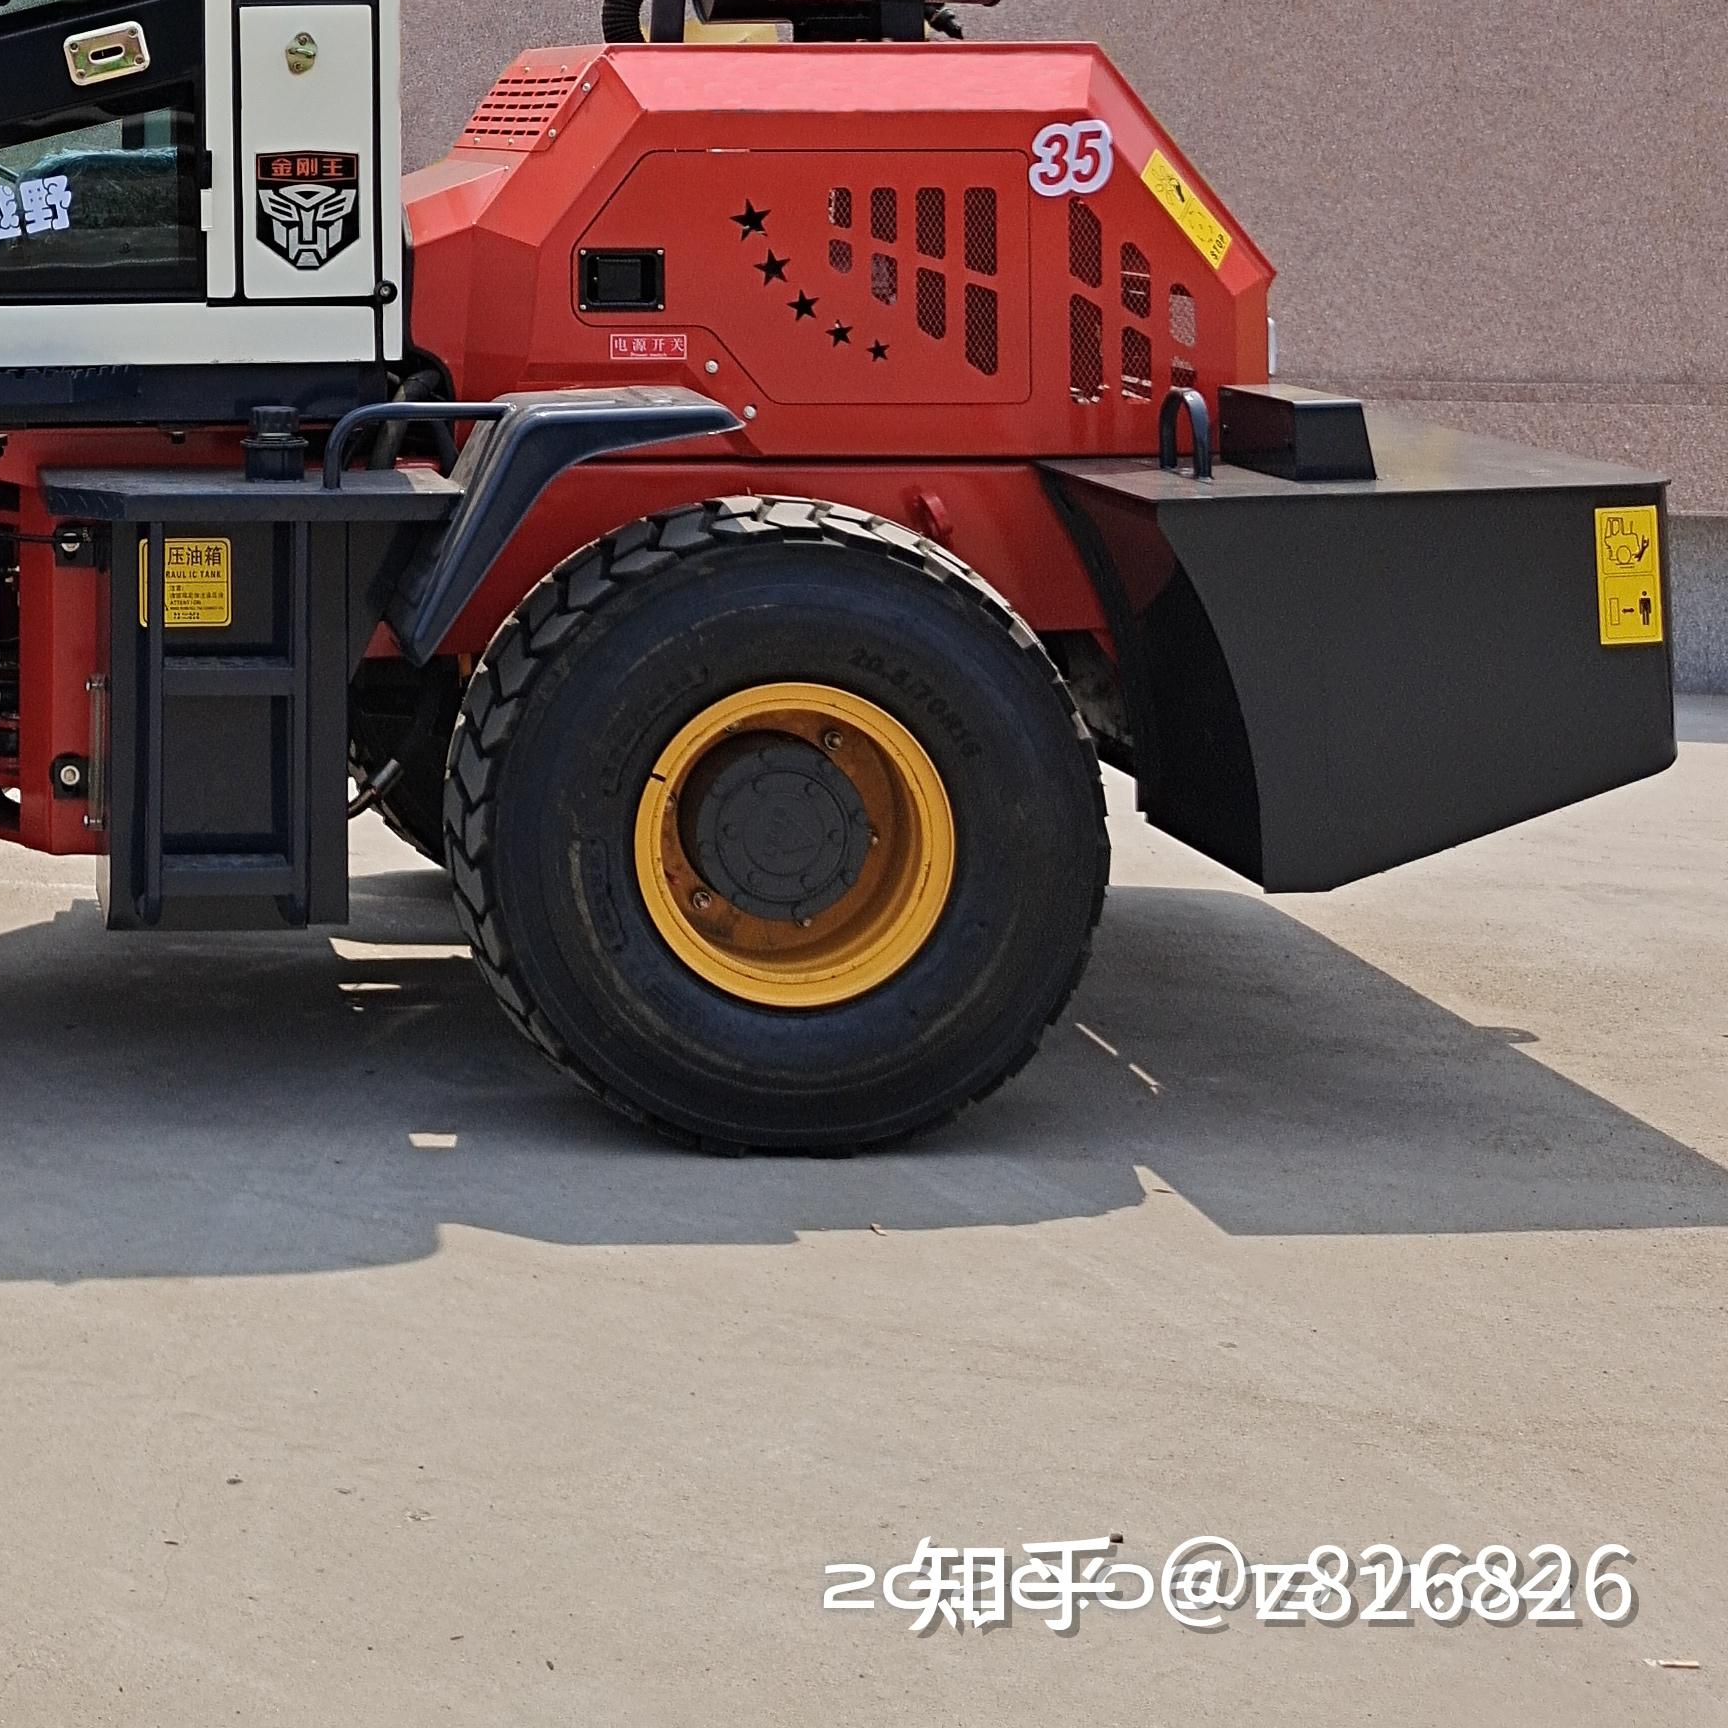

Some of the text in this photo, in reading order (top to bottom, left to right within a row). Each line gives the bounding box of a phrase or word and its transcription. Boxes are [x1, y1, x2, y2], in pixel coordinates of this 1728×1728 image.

[1035, 127, 1105, 188] 35
[271, 157, 344, 177] 金刚王
[614, 337, 685, 352] 电源开关
[200, 570, 222, 579] TANK
